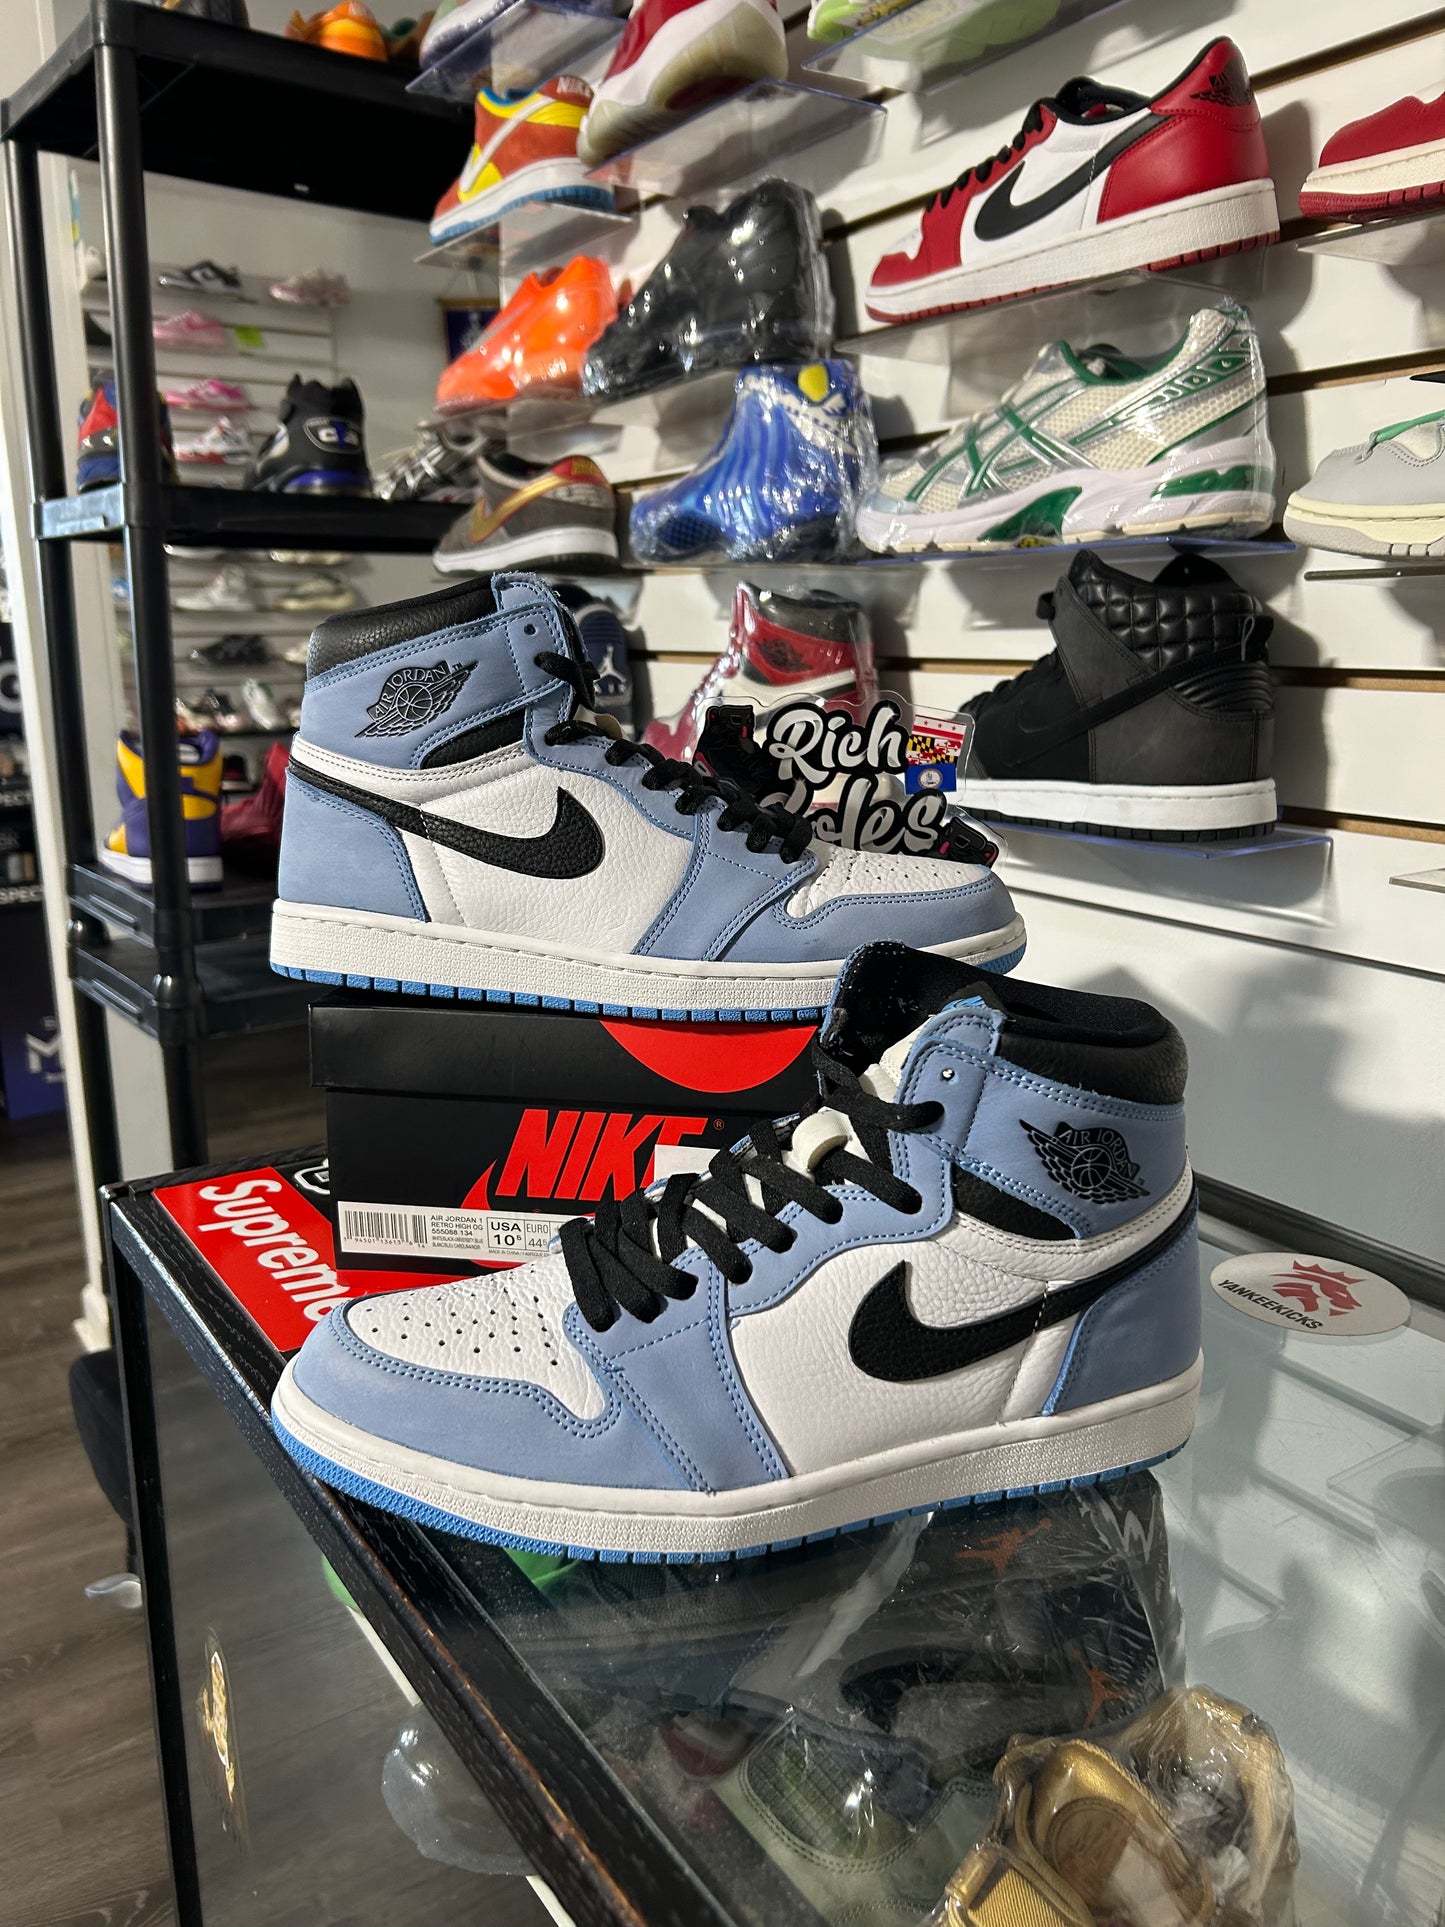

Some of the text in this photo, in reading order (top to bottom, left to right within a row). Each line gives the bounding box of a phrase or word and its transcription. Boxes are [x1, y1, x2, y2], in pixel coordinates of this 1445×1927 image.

[375, 693, 394, 717] AIR
[769, 706, 902, 783] Rich
[761, 777, 942, 853] oles
[1059, 1129, 1091, 1144] AIR
[430, 1214, 444, 1222] AIR
[446, 1215, 477, 1223] JORDAN
[431, 1221, 454, 1229] RETRO
[491, 1221, 522, 1232] USA
[526, 1223, 549, 1234] EURO
[1217, 1279, 1324, 1330] YANKEEKICKS
